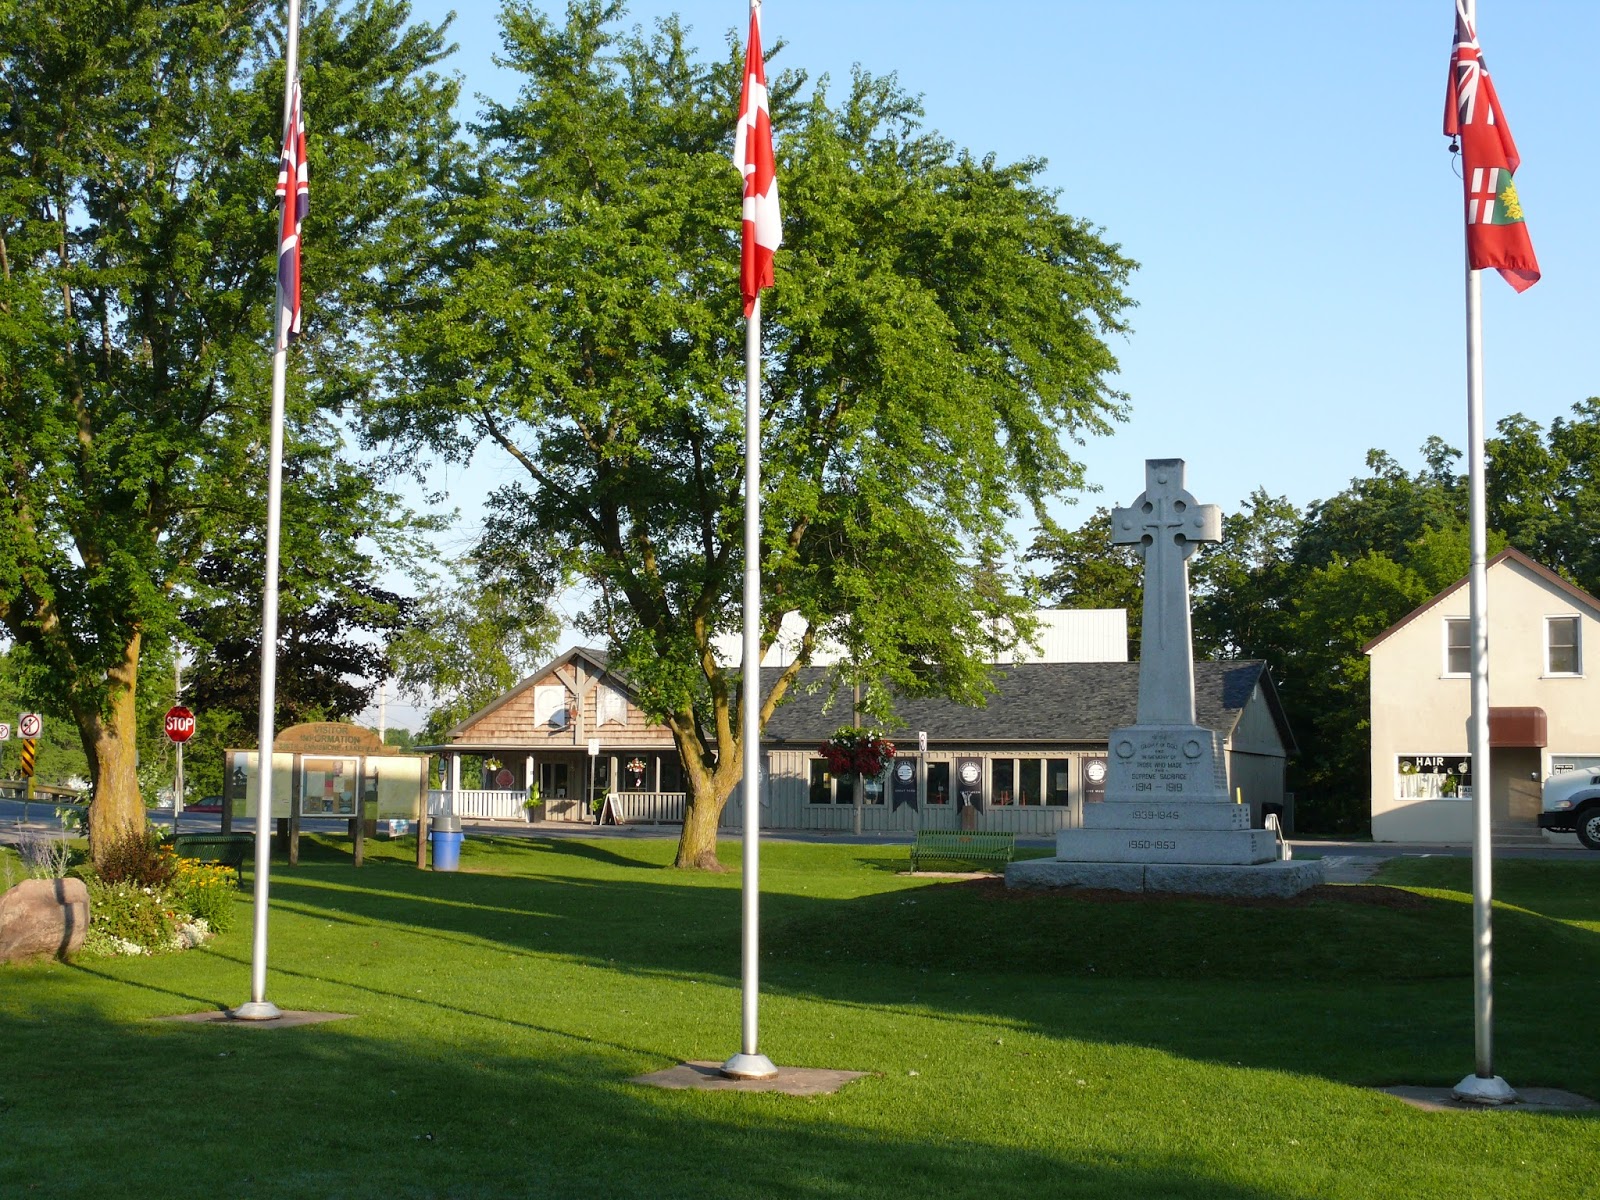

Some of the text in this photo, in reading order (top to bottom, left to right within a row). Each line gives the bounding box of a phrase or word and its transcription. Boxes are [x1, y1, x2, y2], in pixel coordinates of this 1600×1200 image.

[166, 716, 193, 731] STOP
[314, 727, 347, 735] VISITOR
[300, 734, 360, 743] INFORMATION
[1416, 757, 1444, 766] HAIR
[1135, 782, 1152, 791] 1914
[1165, 782, 1183, 792] 1918
[1128, 840, 1176, 850] 1950-1953
